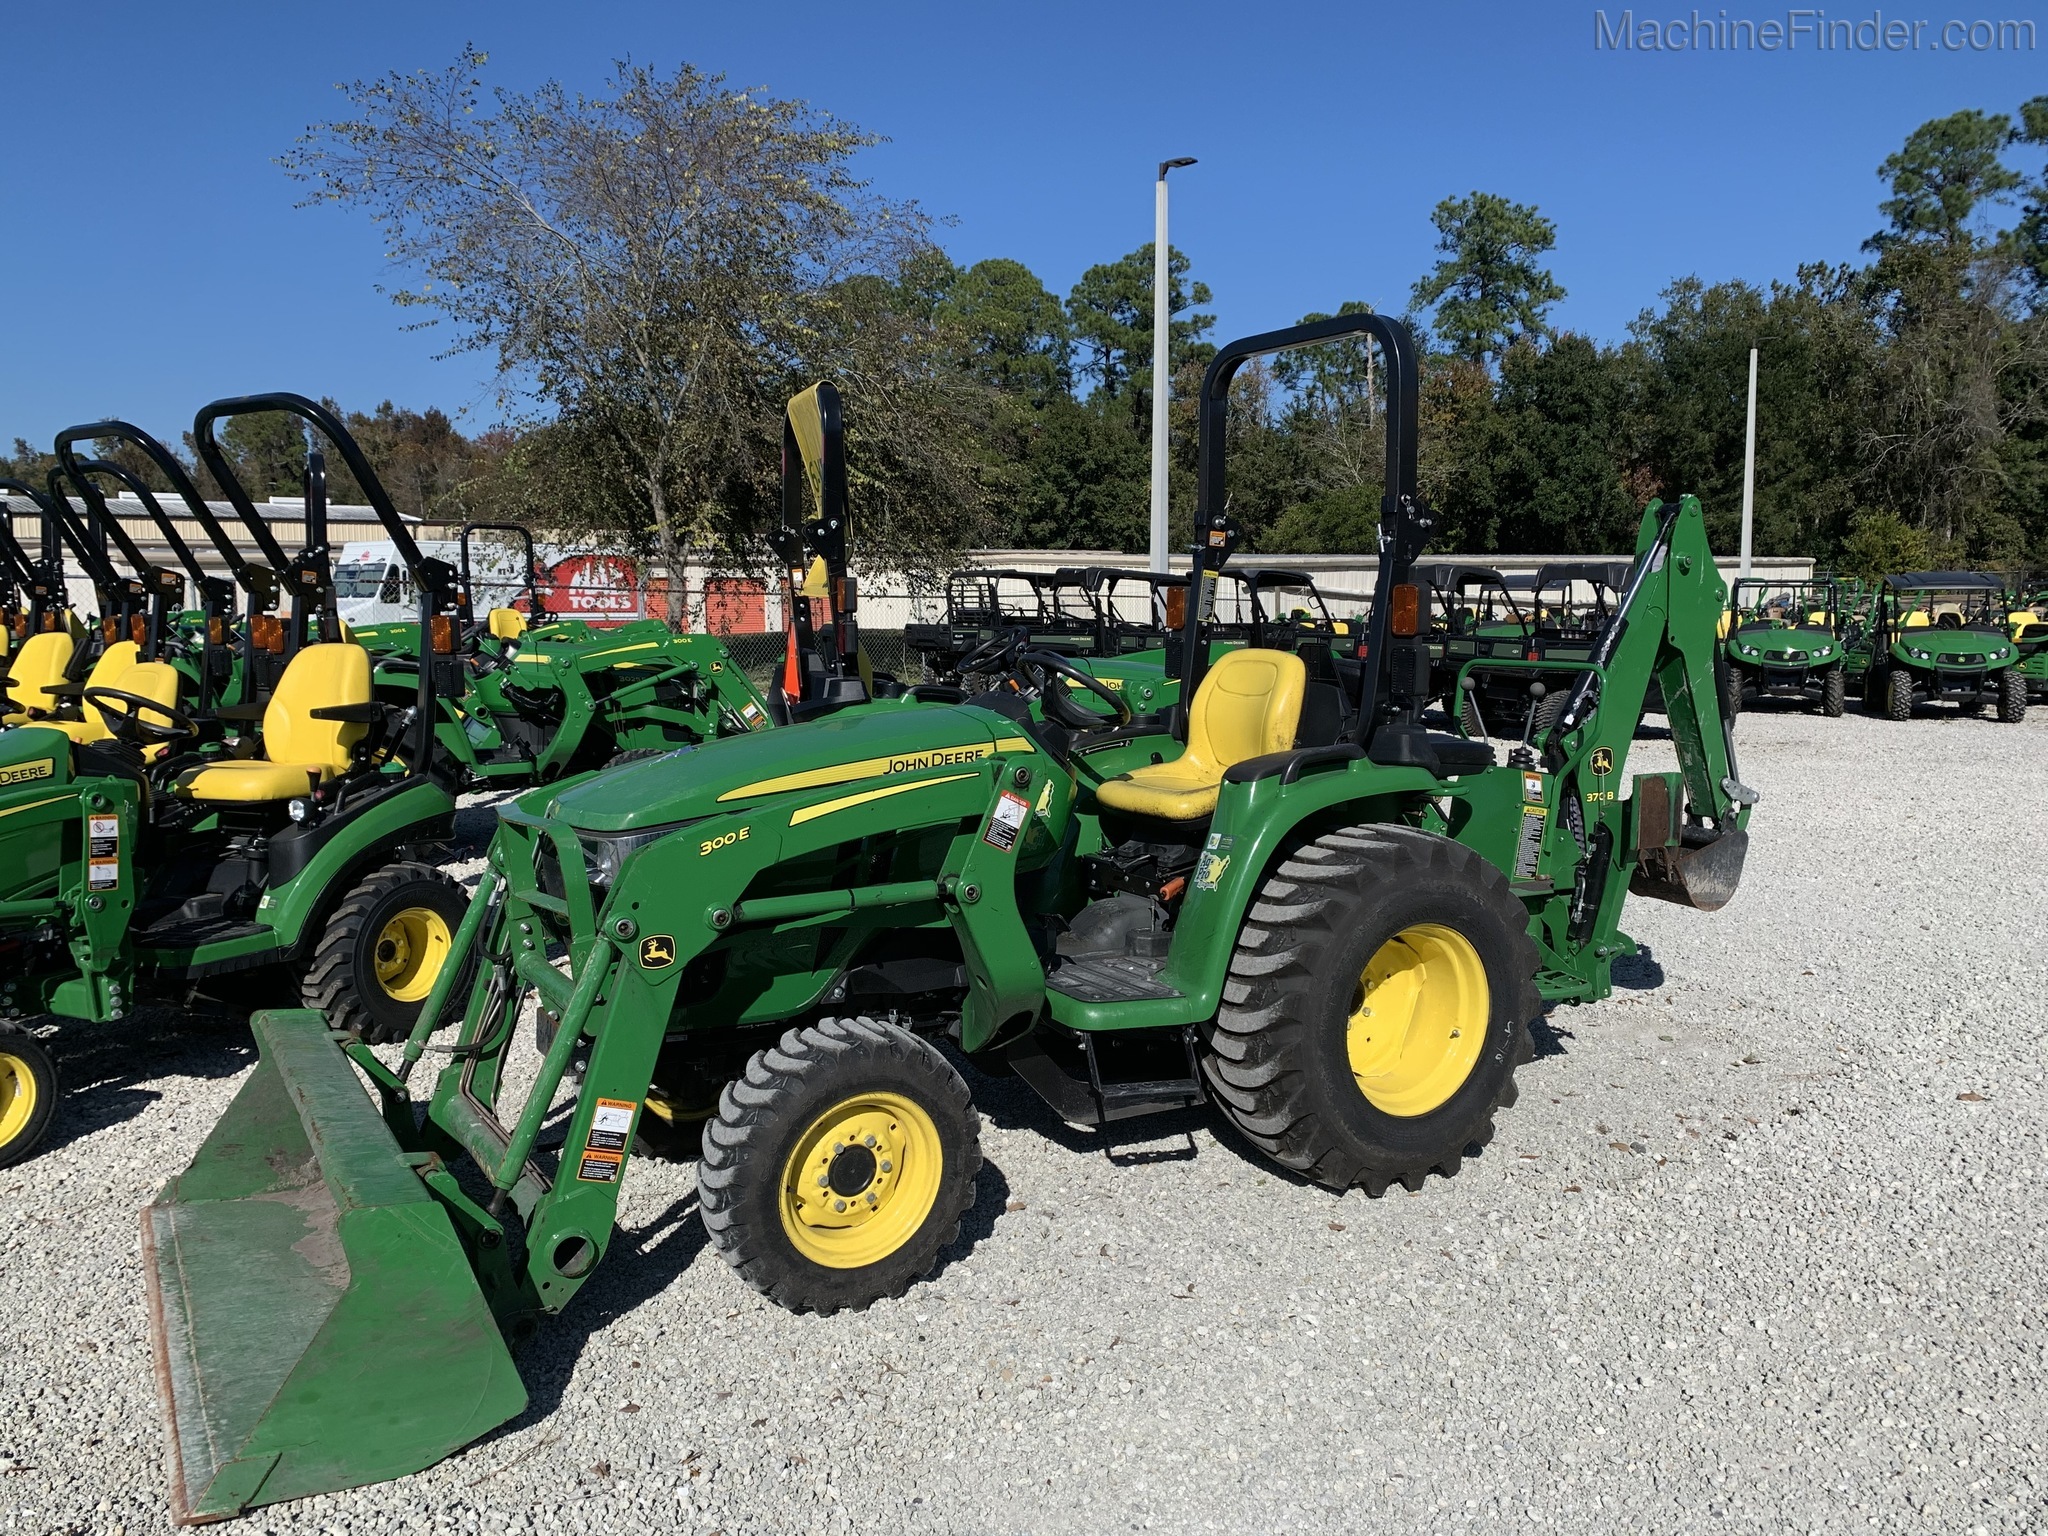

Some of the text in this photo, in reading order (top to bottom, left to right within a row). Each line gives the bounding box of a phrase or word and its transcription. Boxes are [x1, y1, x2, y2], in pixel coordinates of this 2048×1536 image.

[568, 596, 632, 609] TOOLS
[882, 756, 929, 774] JOHN
[0, 766, 47, 783] DEERE
[607, 1101, 632, 1109] WARNING
